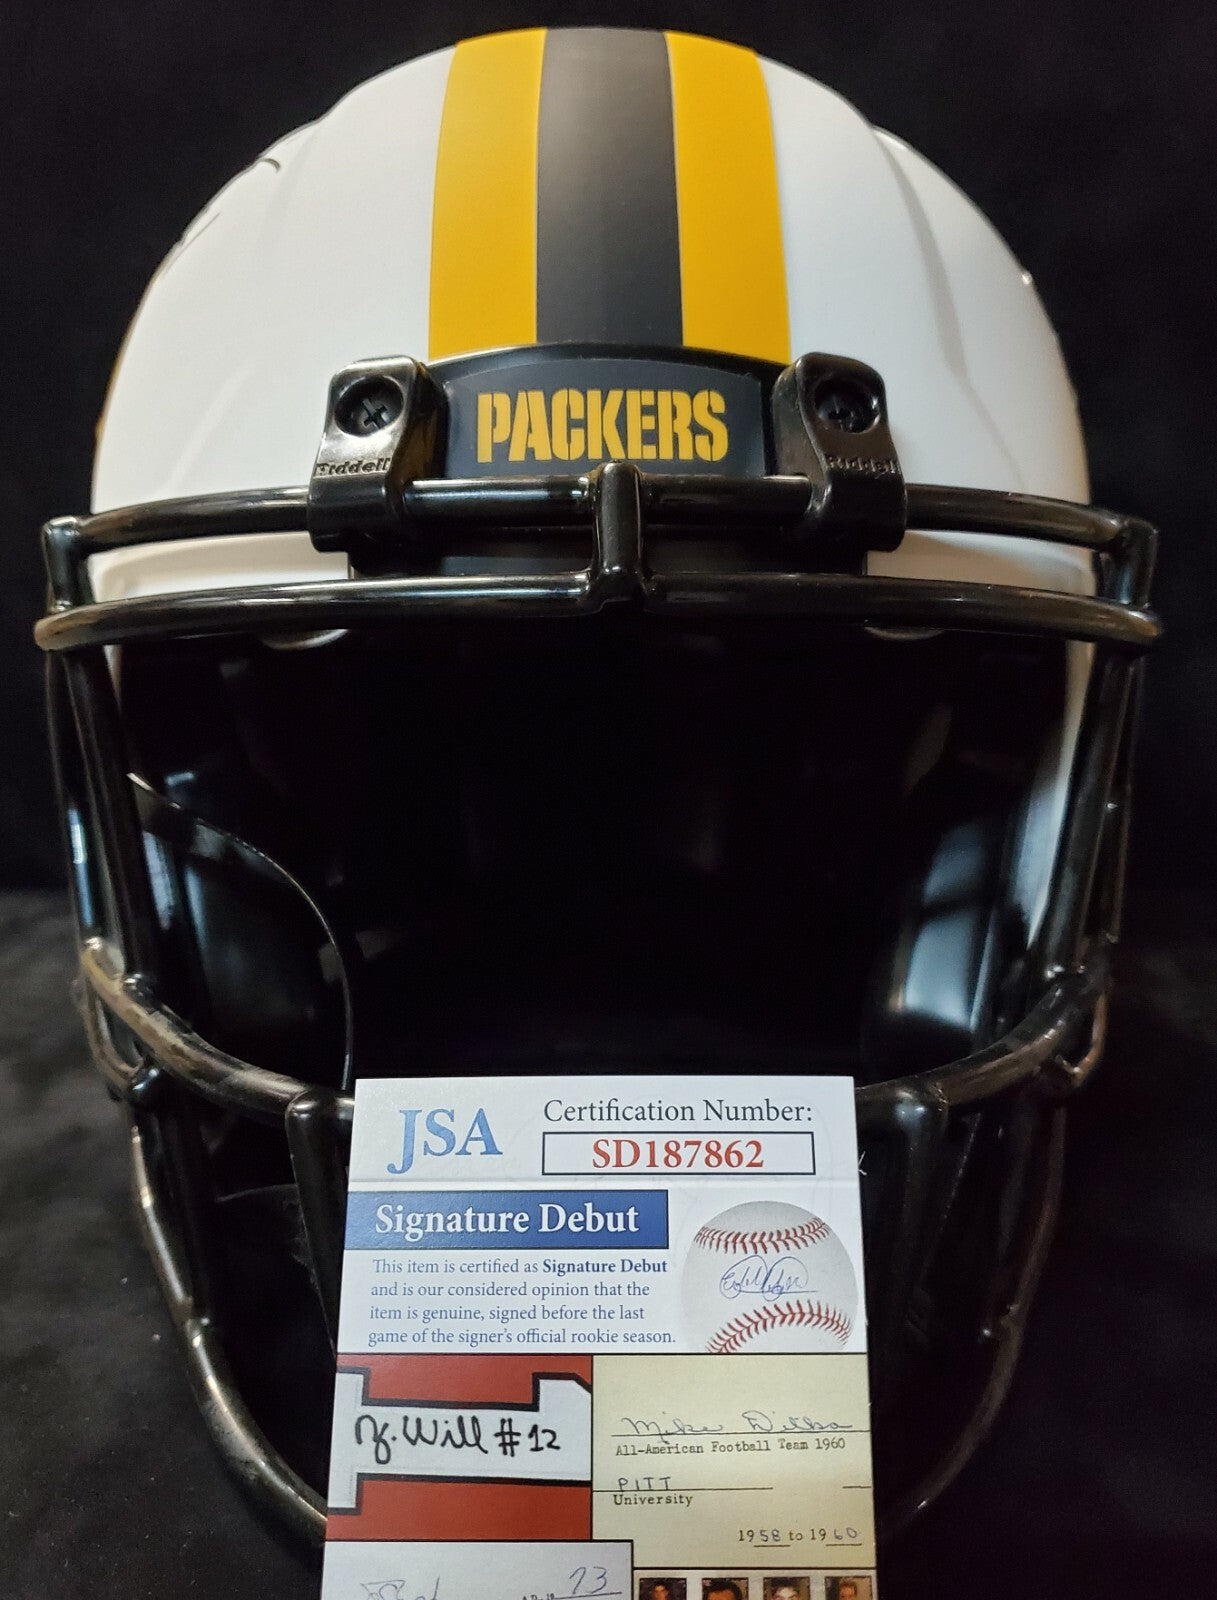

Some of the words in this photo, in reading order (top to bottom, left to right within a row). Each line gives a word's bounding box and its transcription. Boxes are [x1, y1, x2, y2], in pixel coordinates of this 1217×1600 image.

[476, 388, 730, 463] PACKERS
[314, 457, 392, 477] Riddell
[543, 1097, 696, 1123] Certification
[702, 1097, 814, 1123] Number:
[386, 1107, 504, 1175] JSA
[591, 1137, 765, 1170] SD187862
[375, 1202, 530, 1241] Signature
[538, 1203, 640, 1234] Debut
[373, 1259, 402, 1273] This
[407, 1259, 439, 1273] item
[444, 1259, 455, 1273] is
[460, 1259, 519, 1273] certified
[524, 1263, 538, 1272] as
[543, 1259, 616, 1277] Signature
[621, 1259, 667, 1272] Debut
[371, 1282, 397, 1296] and
[403, 1283, 413, 1295] is
[418, 1286, 443, 1296] our
[448, 1282, 527, 1296] considered
[532, 1283, 589, 1300] opinion
[594, 1282, 622, 1295] that
[627, 1281, 649, 1295] the
[370, 1306, 401, 1319] item
[407, 1306, 418, 1319] is
[422, 1306, 485, 1323] genuine,
[489, 1305, 537, 1324] signed
[542, 1305, 587, 1319] before
[593, 1305, 615, 1319] the
[620, 1305, 644, 1319] last
[368, 1332, 407, 1347] game
[412, 1328, 429, 1343] of
[432, 1328, 454, 1343] the
[517, 1328, 566, 1343] official
[571, 1329, 618, 1343] rookie
[623, 1332, 675, 1343] season.
[402, 1415, 488, 1454] Will
[494, 1417, 561, 1457] #12
[615, 1440, 704, 1456] All-American
[711, 1437, 771, 1453] Football
[777, 1436, 809, 1450] Team
[815, 1436, 846, 1450] 1960
[617, 1476, 672, 1491] PITT
[613, 1493, 694, 1507] University
[788, 1529, 804, 1542] to
